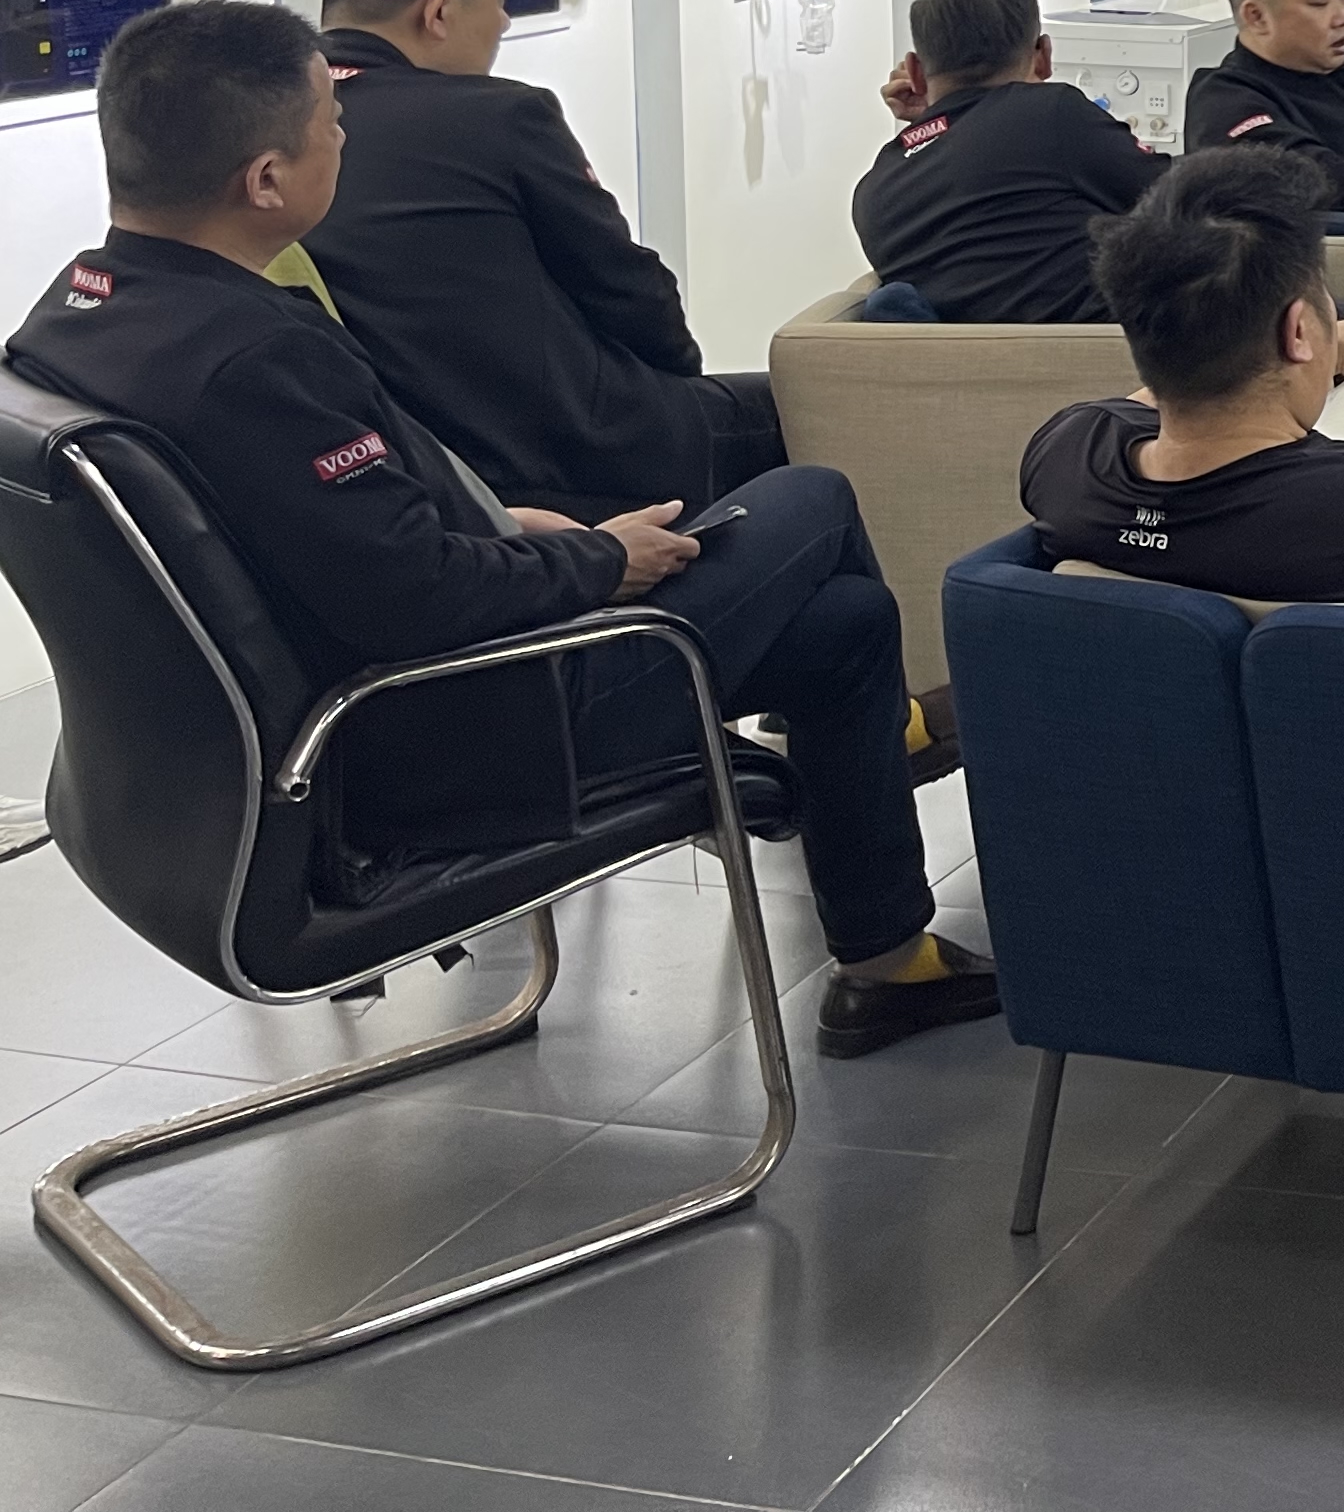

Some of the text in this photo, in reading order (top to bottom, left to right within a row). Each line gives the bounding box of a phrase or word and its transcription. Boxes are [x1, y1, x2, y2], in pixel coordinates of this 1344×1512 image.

[903, 120, 948, 146] VOOMA
[319, 436, 387, 473] VOOM
[1118, 528, 1169, 550] zebra
